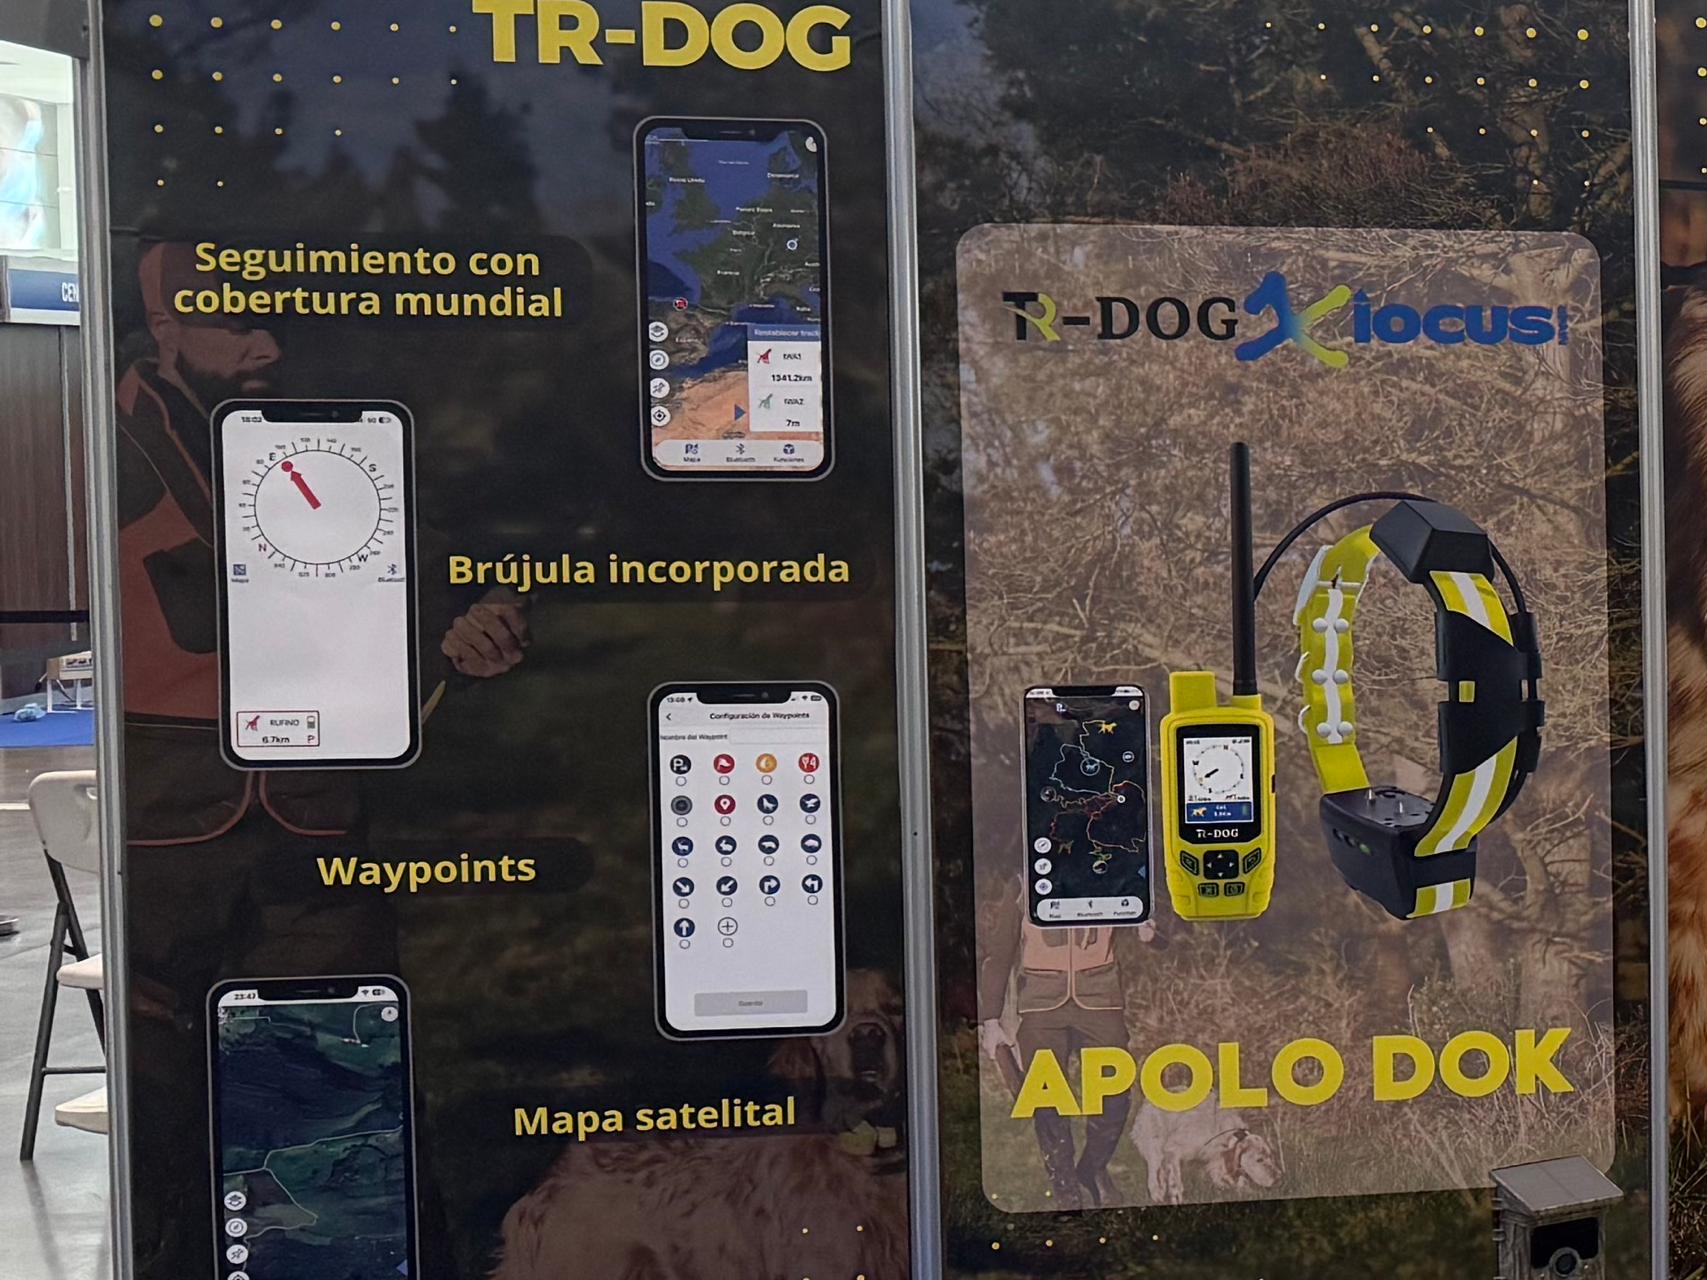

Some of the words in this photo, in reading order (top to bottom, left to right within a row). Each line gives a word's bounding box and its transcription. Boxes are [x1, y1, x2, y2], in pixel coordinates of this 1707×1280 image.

[195, 242, 456, 282] Seguimiento
[469, 249, 541, 277] con
[173, 286, 390, 317] cobertura
[398, 286, 564, 319] mundial
[448, 554, 597, 587] Brújula
[608, 555, 850, 590] incorporada
[316, 851, 537, 895] Waypoints
[1010, 1038, 1344, 1120] APOLO
[1373, 1027, 1575, 1102] DOK
[512, 1104, 625, 1142] Mapa
[634, 1096, 797, 1136] satelital
